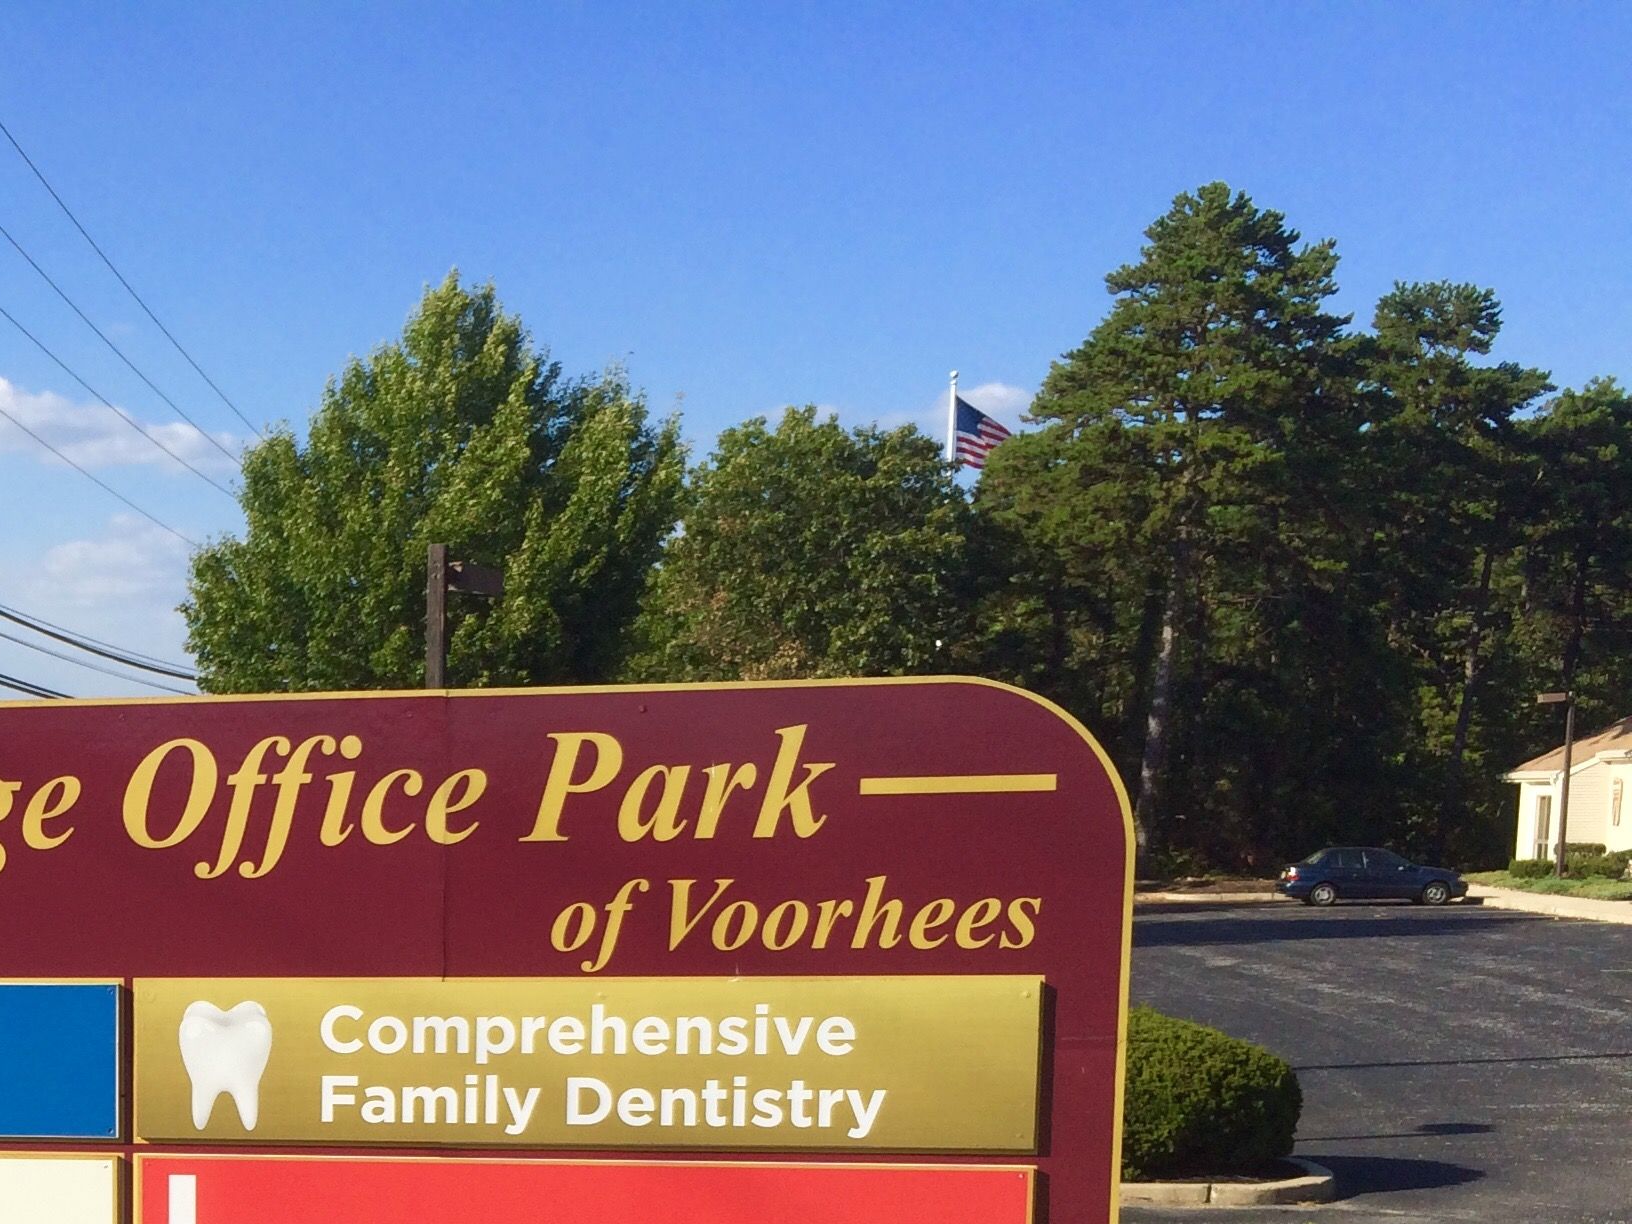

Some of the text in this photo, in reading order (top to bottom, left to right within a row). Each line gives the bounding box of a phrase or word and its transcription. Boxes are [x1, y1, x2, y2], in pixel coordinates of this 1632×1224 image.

[122, 734, 487, 879] Office
[518, 724, 836, 842] Park
[551, 875, 1042, 973] of Voorhees
[320, 1003, 857, 1065] Comprehensive
[321, 1074, 887, 1139] Family Dentistry
